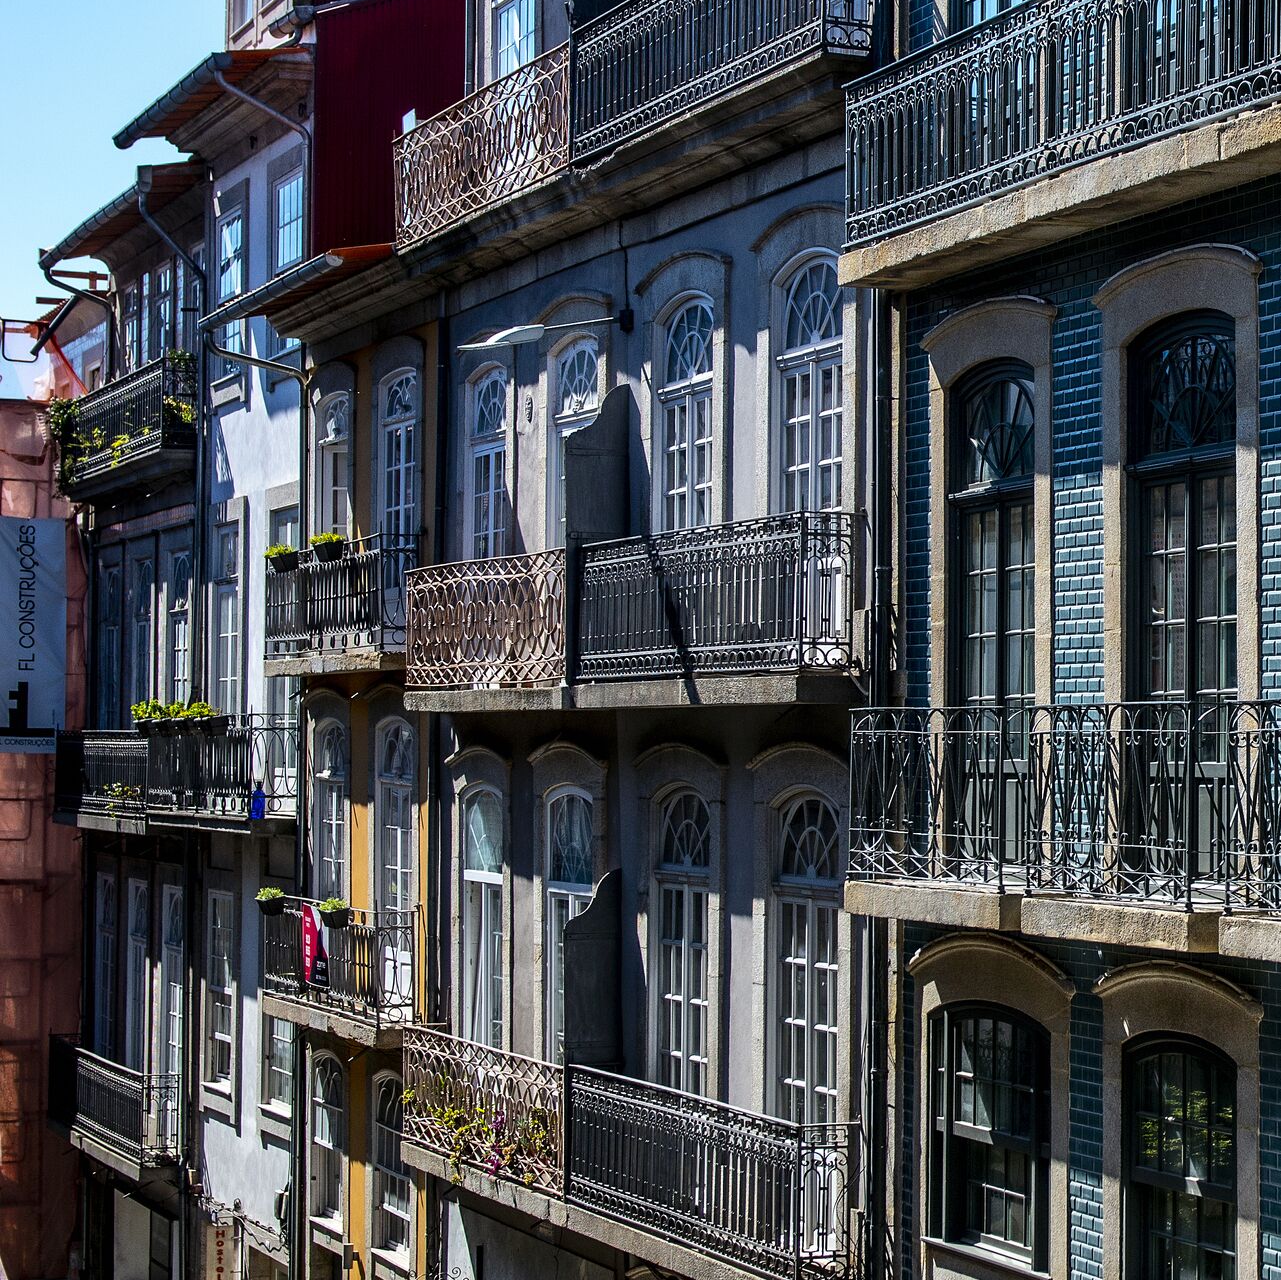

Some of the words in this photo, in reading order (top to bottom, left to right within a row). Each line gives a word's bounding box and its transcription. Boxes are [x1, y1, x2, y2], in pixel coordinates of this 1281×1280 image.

[16, 524, 39, 649] CONSTRUÇÕES
[18, 653, 35, 671] FL
[4, 737, 55, 748] CONSTRUÇÕES
